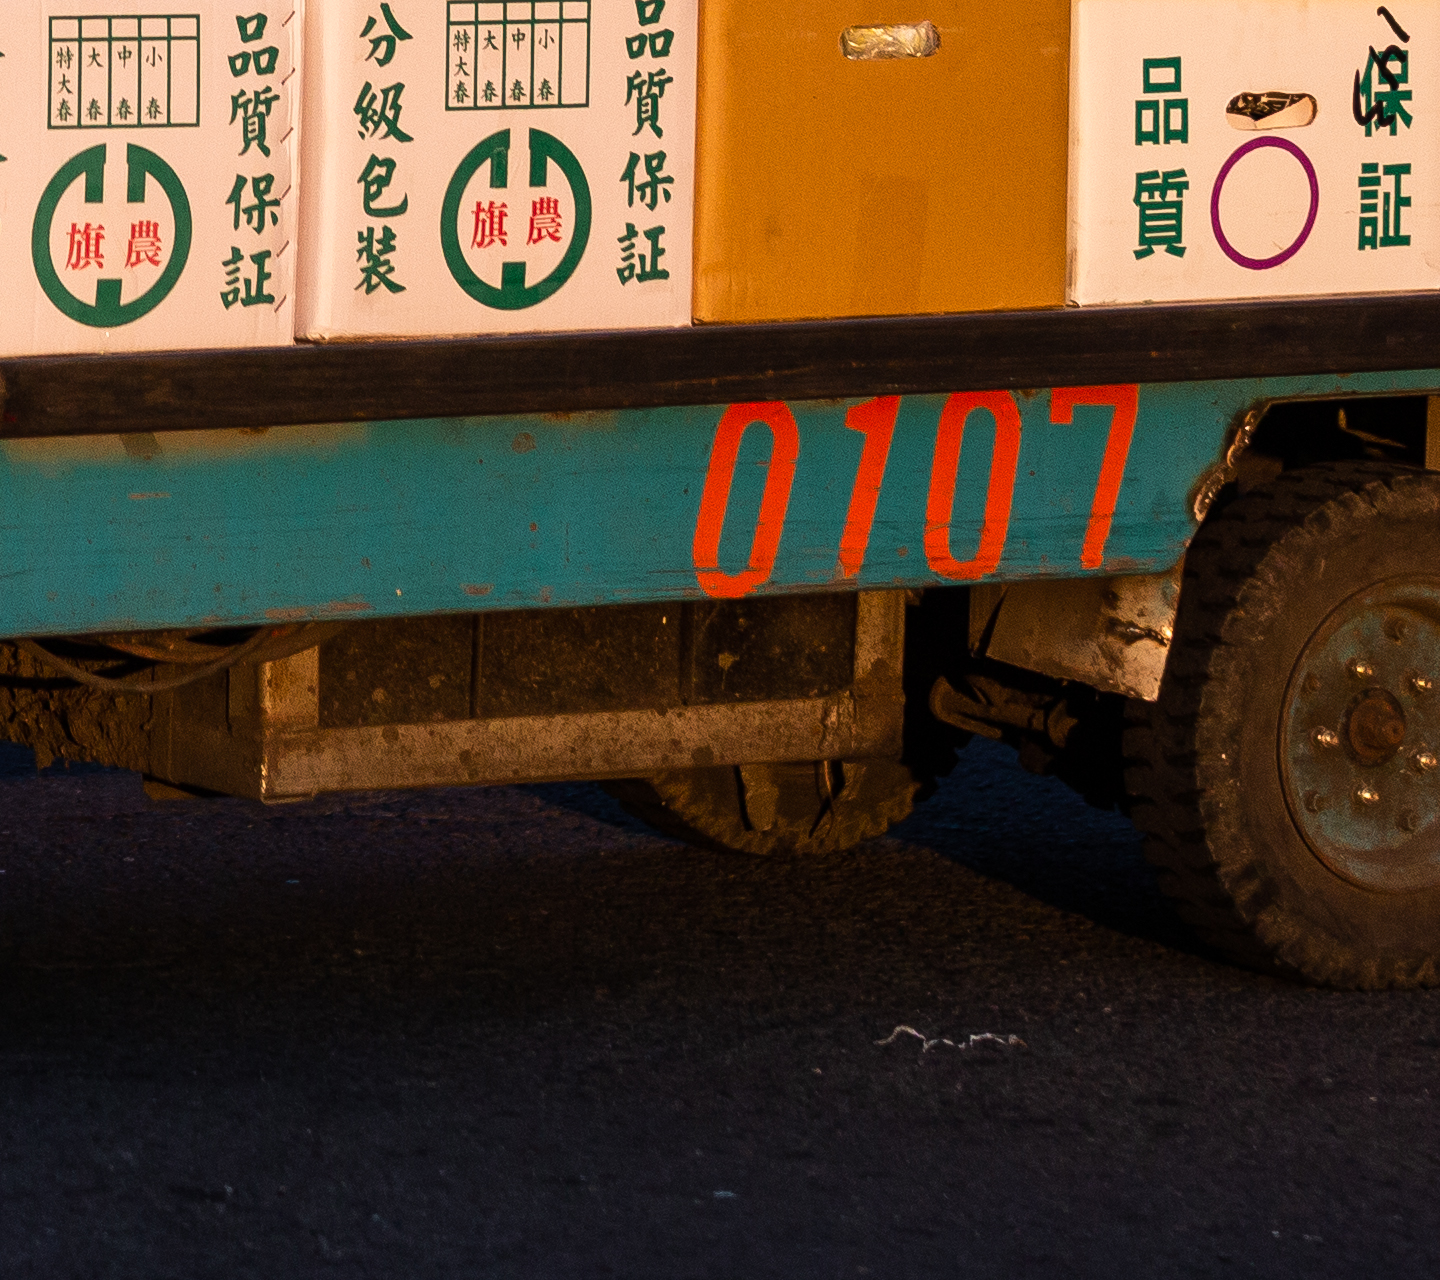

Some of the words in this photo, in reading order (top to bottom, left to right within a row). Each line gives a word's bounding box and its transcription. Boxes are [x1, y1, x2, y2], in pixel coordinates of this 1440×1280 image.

[219, 11, 281, 310] 品質保証
[352, 2, 413, 296] 分級包裝
[1132, 56, 1189, 260] 品質
[692, 382, 1139, 599] 0107
